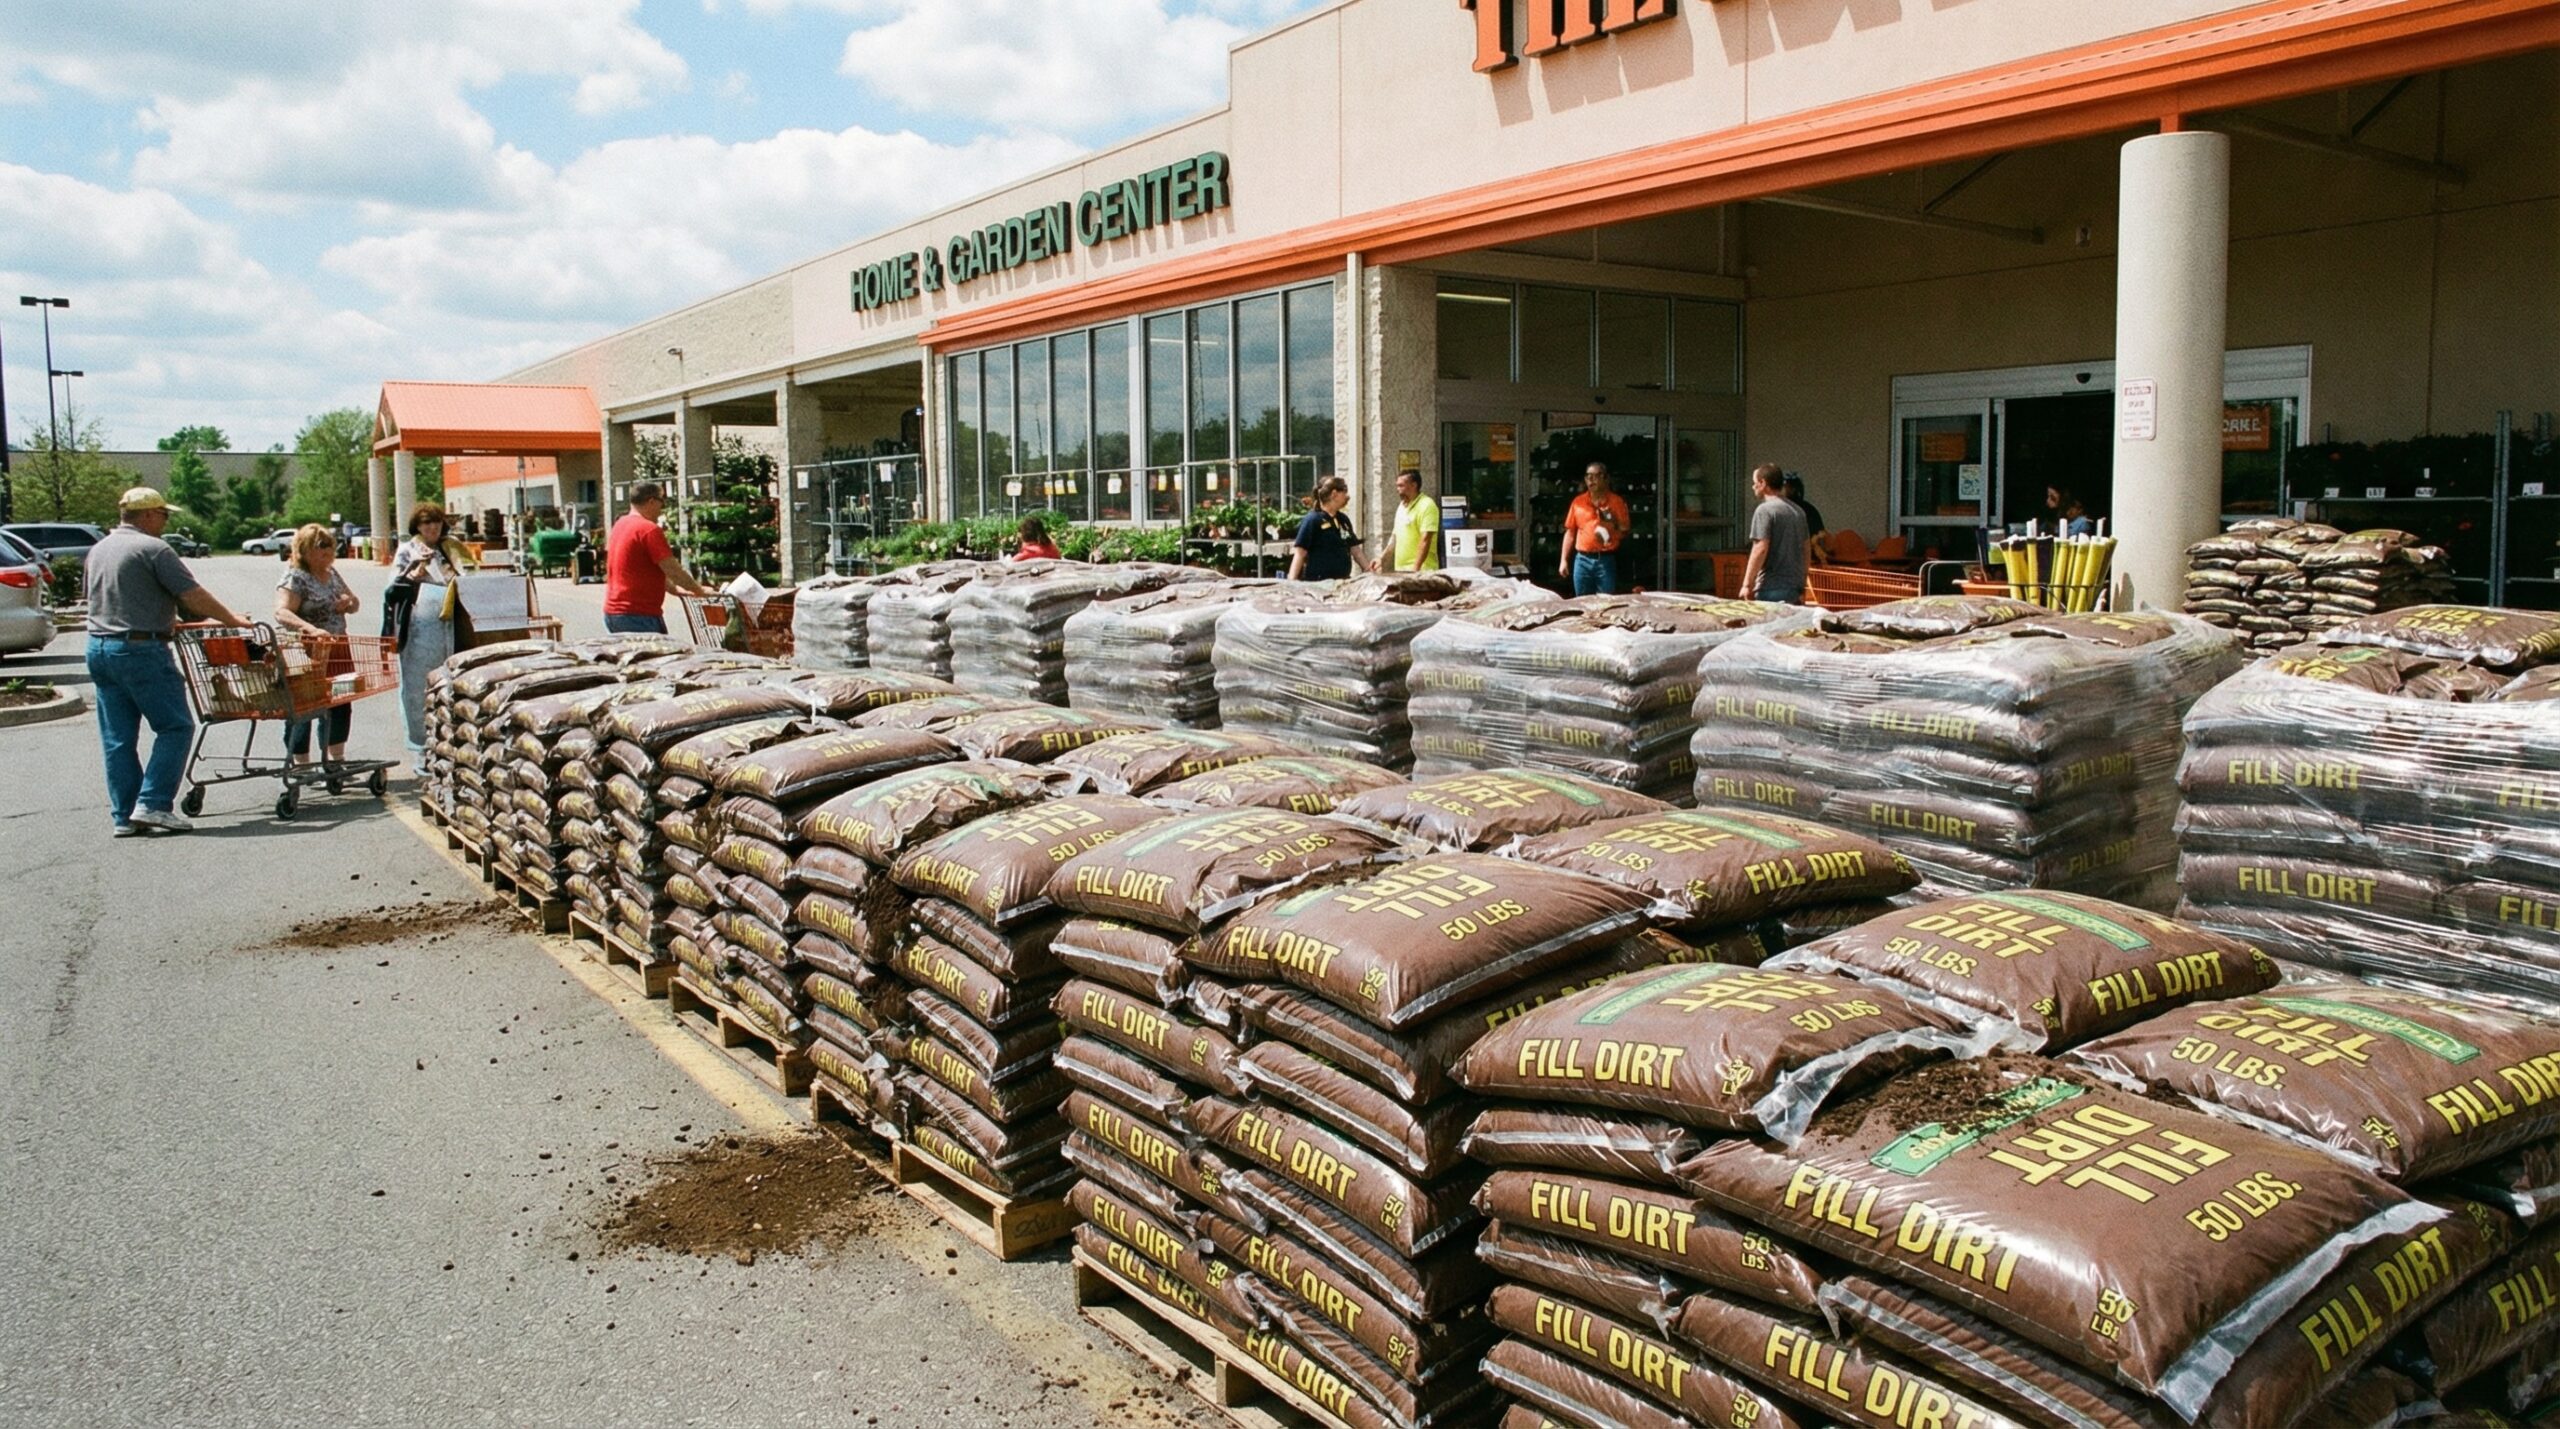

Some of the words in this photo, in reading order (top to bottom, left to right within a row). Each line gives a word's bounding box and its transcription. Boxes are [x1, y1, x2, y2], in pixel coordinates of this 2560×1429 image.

[850, 252, 919, 312] HOME
[923, 246, 943, 292] &
[947, 201, 1070, 285] GARDEN
[1076, 151, 1230, 246] CENTER
[1715, 696, 1749, 717] FILL
[1755, 700, 1799, 725] DIRT
[1870, 709, 1918, 731] FILL
[1923, 712, 1979, 742] DIRT
[1526, 722, 1560, 743] FILL
[1563, 728, 1601, 748] DIRT
[1714, 777, 1749, 798] FILL
[1755, 782, 1797, 807] DIRT
[2228, 759, 2284, 786] FILL
[2294, 761, 2364, 790] DIRT
[839, 816, 876, 846] DIRT
[1871, 802, 1916, 830] FILL
[1922, 812, 1977, 842] DIRT
[1048, 842, 1076, 862] 50
[1254, 847, 1287, 869] 50
[1285, 832, 1336, 857] LBS.
[1608, 849, 1653, 873] LBS.
[1744, 859, 1806, 895] FILL
[1807, 851, 1868, 882] DIRT
[940, 860, 981, 897] DIRT
[1076, 866, 1114, 896] FILL
[1119, 871, 1174, 905] DIRT
[1371, 875, 1498, 920] FILL
[2238, 866, 2297, 896] FILL
[2305, 871, 2377, 905] DIRT
[1440, 916, 1479, 942] 50
[1473, 898, 1532, 927] LBS.
[1904, 914, 2045, 959] DIRT
[1948, 903, 2069, 947] FILL
[908, 944, 932, 977] FILL
[934, 958, 968, 997] DIRT
[1228, 925, 1270, 960] FILL
[1274, 931, 1341, 979] DIRT
[1883, 936, 1922, 958] 50
[1920, 945, 1978, 978] LBS.
[2087, 968, 2158, 1016] FILL
[2155, 951, 2225, 998] DIRT
[1082, 989, 1118, 1027] FILL
[1123, 1006, 1172, 1050] DIRT
[1790, 1008, 1833, 1034] 50
[910, 1036, 938, 1066] FILL
[941, 1058, 976, 1094] DIRT
[1517, 1038, 1585, 1079] FILL
[1594, 1040, 1686, 1090] DIRT
[2170, 1036, 2220, 1065] 50
[2214, 1049, 2288, 1091] LBS.
[2424, 1077, 2516, 1135] FILL
[941, 1142, 978, 1177] DIRT
[1088, 1102, 1126, 1148] FILL
[1129, 1130, 1181, 1178] DIRT
[1236, 1111, 1283, 1163] FILL
[1290, 1137, 1358, 1201] DIRT
[1986, 1104, 2157, 1187] DIRT
[2063, 1129, 2232, 1204] FILL
[1383, 1195, 1406, 1216] 50
[1530, 1178, 1597, 1233] FILL
[1607, 1194, 1696, 1255] DIRT
[2186, 1199, 2243, 1243] 50
[2232, 1171, 2304, 1223] LBS.
[1093, 1194, 1130, 1235] FILL
[1134, 1219, 1183, 1270] DIRT
[1742, 1231, 1773, 1255] 50
[1784, 1164, 1882, 1240] FILL
[1896, 1200, 2024, 1293] DIRT
[1107, 1241, 1151, 1286] FILL
[1248, 1235, 1296, 1291] FILL
[1301, 1269, 1364, 1333] DIRT
[2098, 1286, 2140, 1325] 50
[2298, 1284, 2383, 1374] FILL
[2372, 1226, 2451, 1314] DIRT
[2488, 1265, 2557, 1335] FILL
[1534, 1297, 1599, 1358] FILL
[1607, 1336, 1693, 1399] DIRT
[1246, 1328, 1291, 1379] FILL
[1296, 1360, 1357, 1420] DIRT
[1763, 1323, 1852, 1403] FILL
[1864, 1363, 1990, 1429] DIRT
[1732, 1391, 1761, 1422] 50
